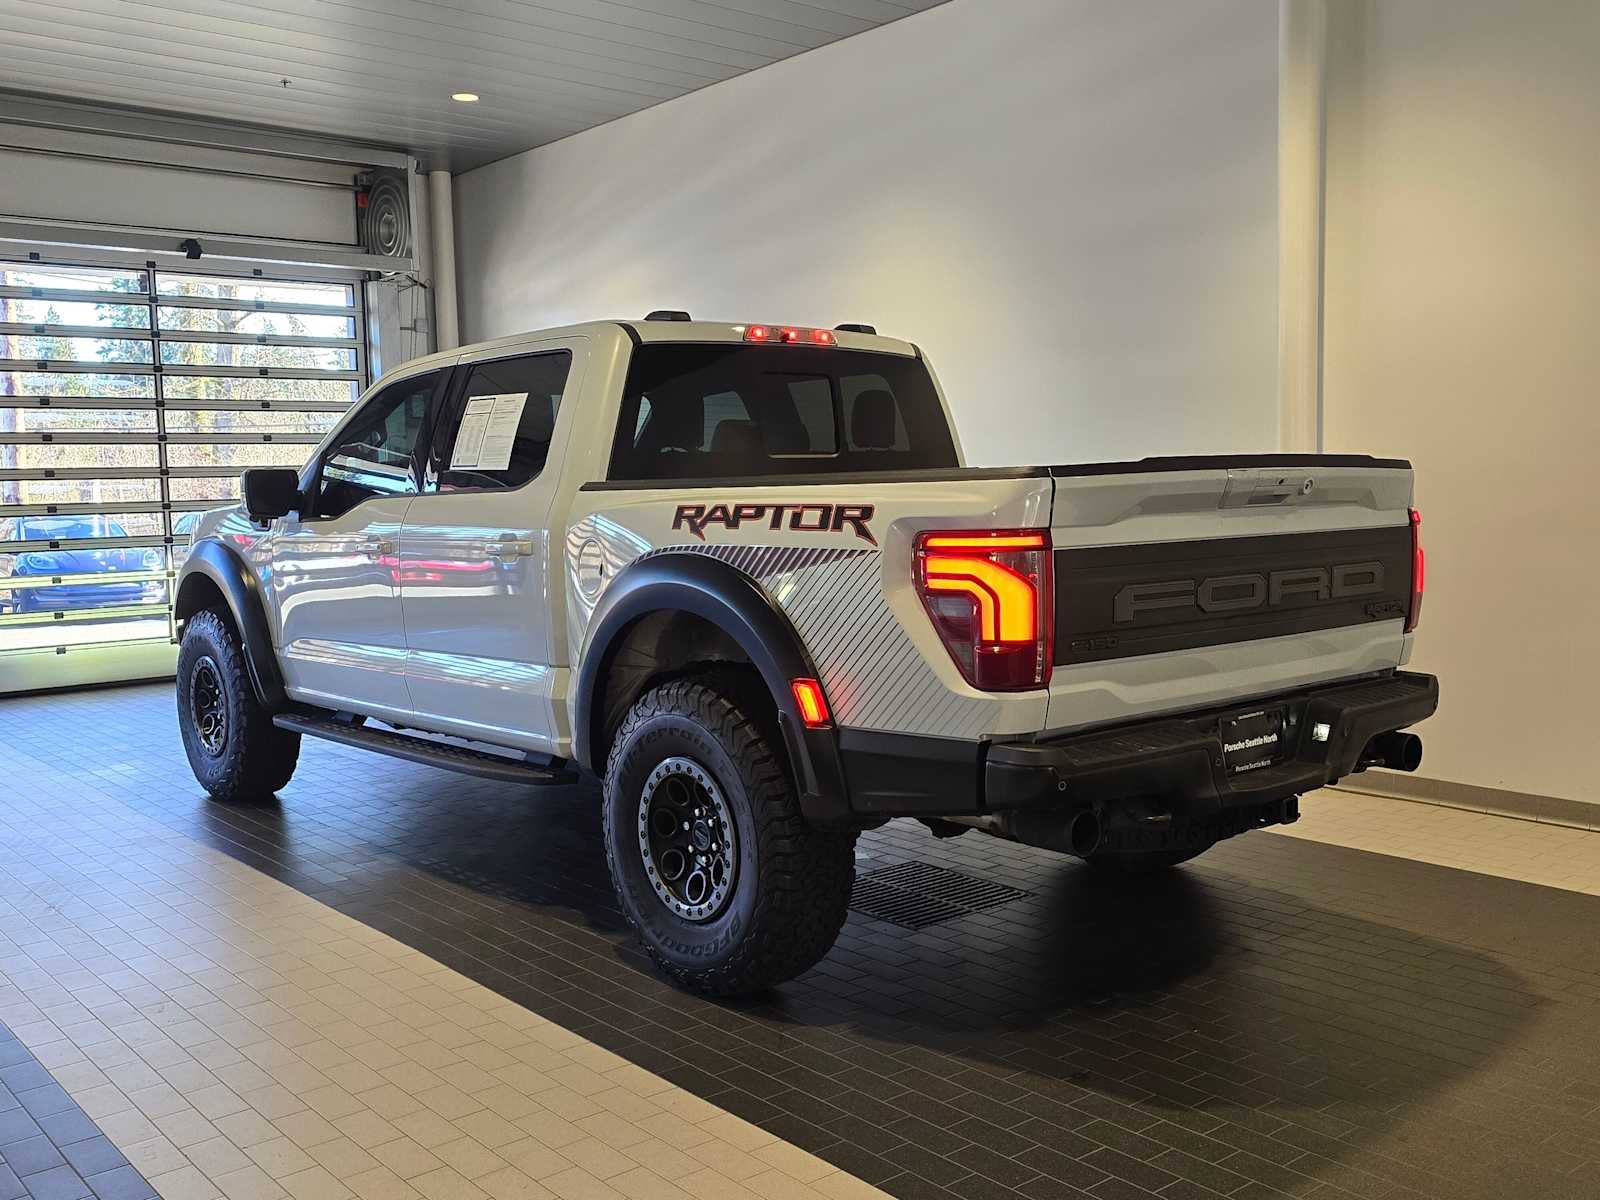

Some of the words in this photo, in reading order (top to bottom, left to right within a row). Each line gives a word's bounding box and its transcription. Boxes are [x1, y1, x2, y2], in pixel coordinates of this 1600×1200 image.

[672, 503, 878, 547] RAPTOR
[1112, 560, 1385, 625] FORD
[1224, 741, 1246, 753] Porsche
[1245, 737, 1263, 748] Seattle
[1263, 732, 1278, 744] North
